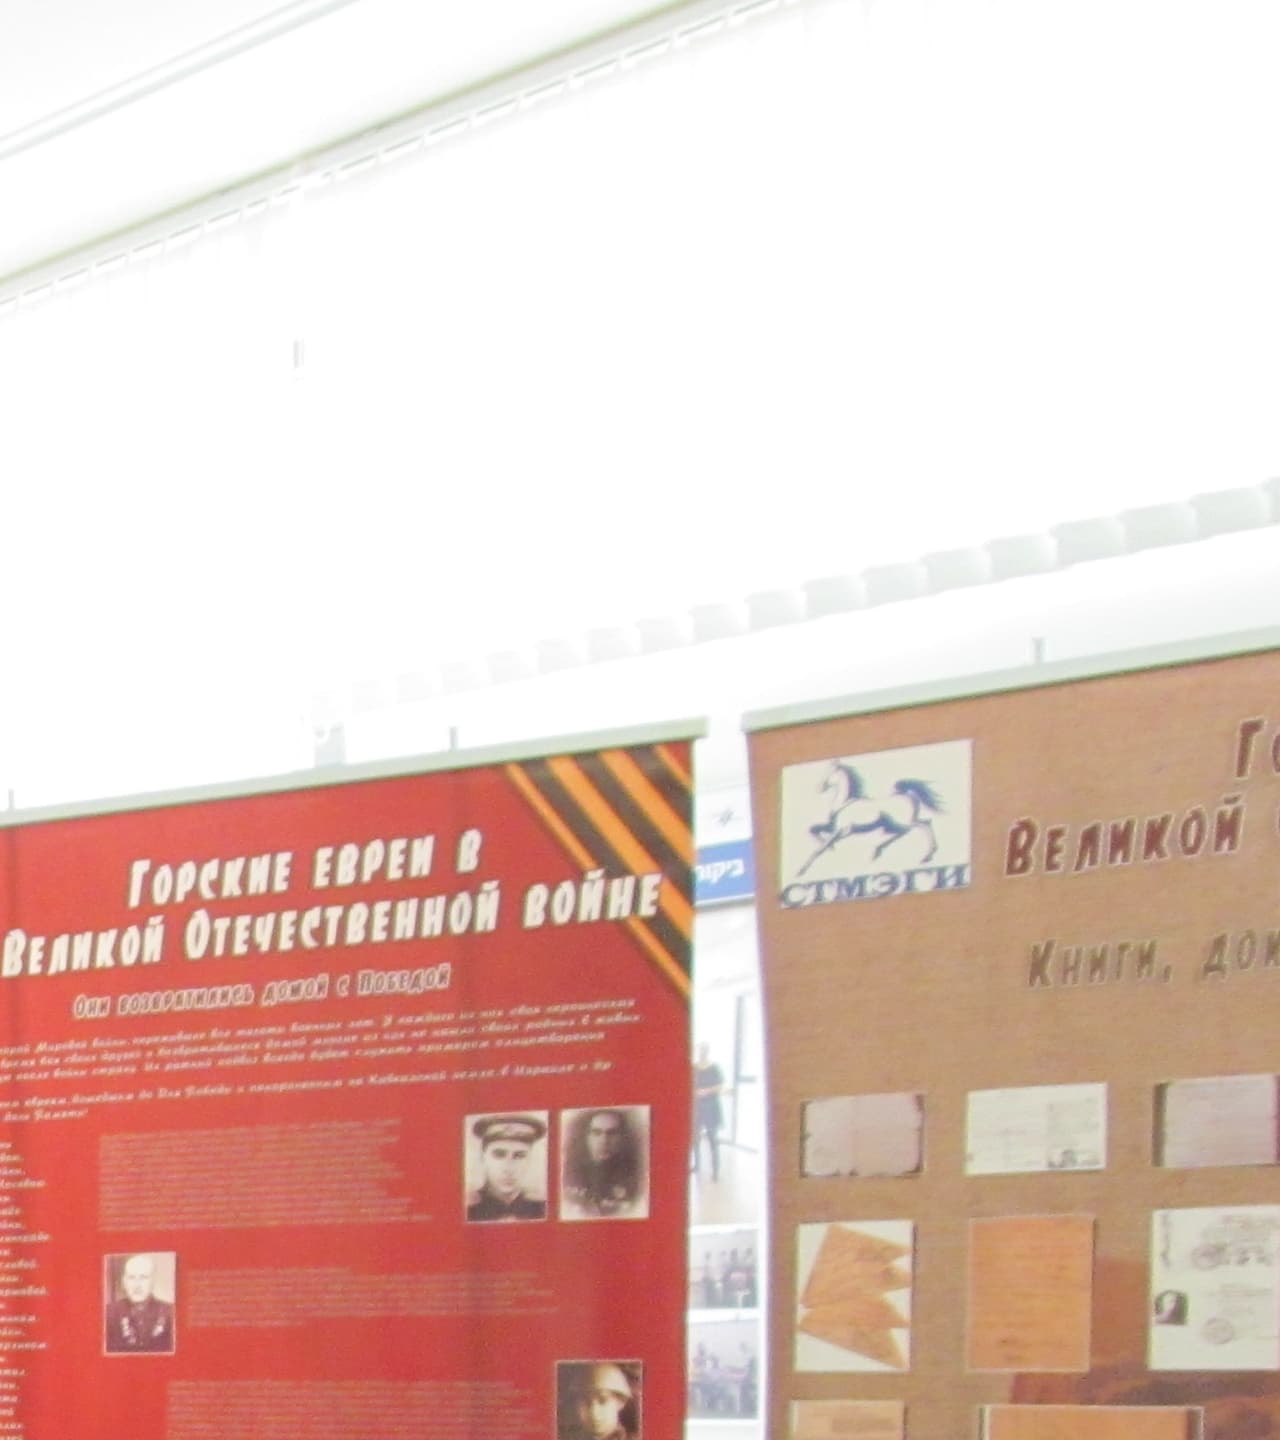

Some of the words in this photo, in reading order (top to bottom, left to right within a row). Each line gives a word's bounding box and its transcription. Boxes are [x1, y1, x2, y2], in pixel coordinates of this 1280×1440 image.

[125, 849, 292, 909] ГОРСКИЕ
[311, 834, 435, 888] ЕВРЕИ
[455, 828, 483, 874] В
[1005, 796, 1245, 877] ВЕЛИКОЙ
[780, 863, 970, 909] СТМЭГИ
[0, 912, 165, 980] ВЕЛИКОЙ
[183, 878, 500, 962] ОТЕЧЕСТВЕННОЙ
[522, 867, 663, 930] ВОЙНЕ
[356, 963, 452, 997] ПОБЕДОЙ
[1028, 938, 1172, 988] КНИГИ,
